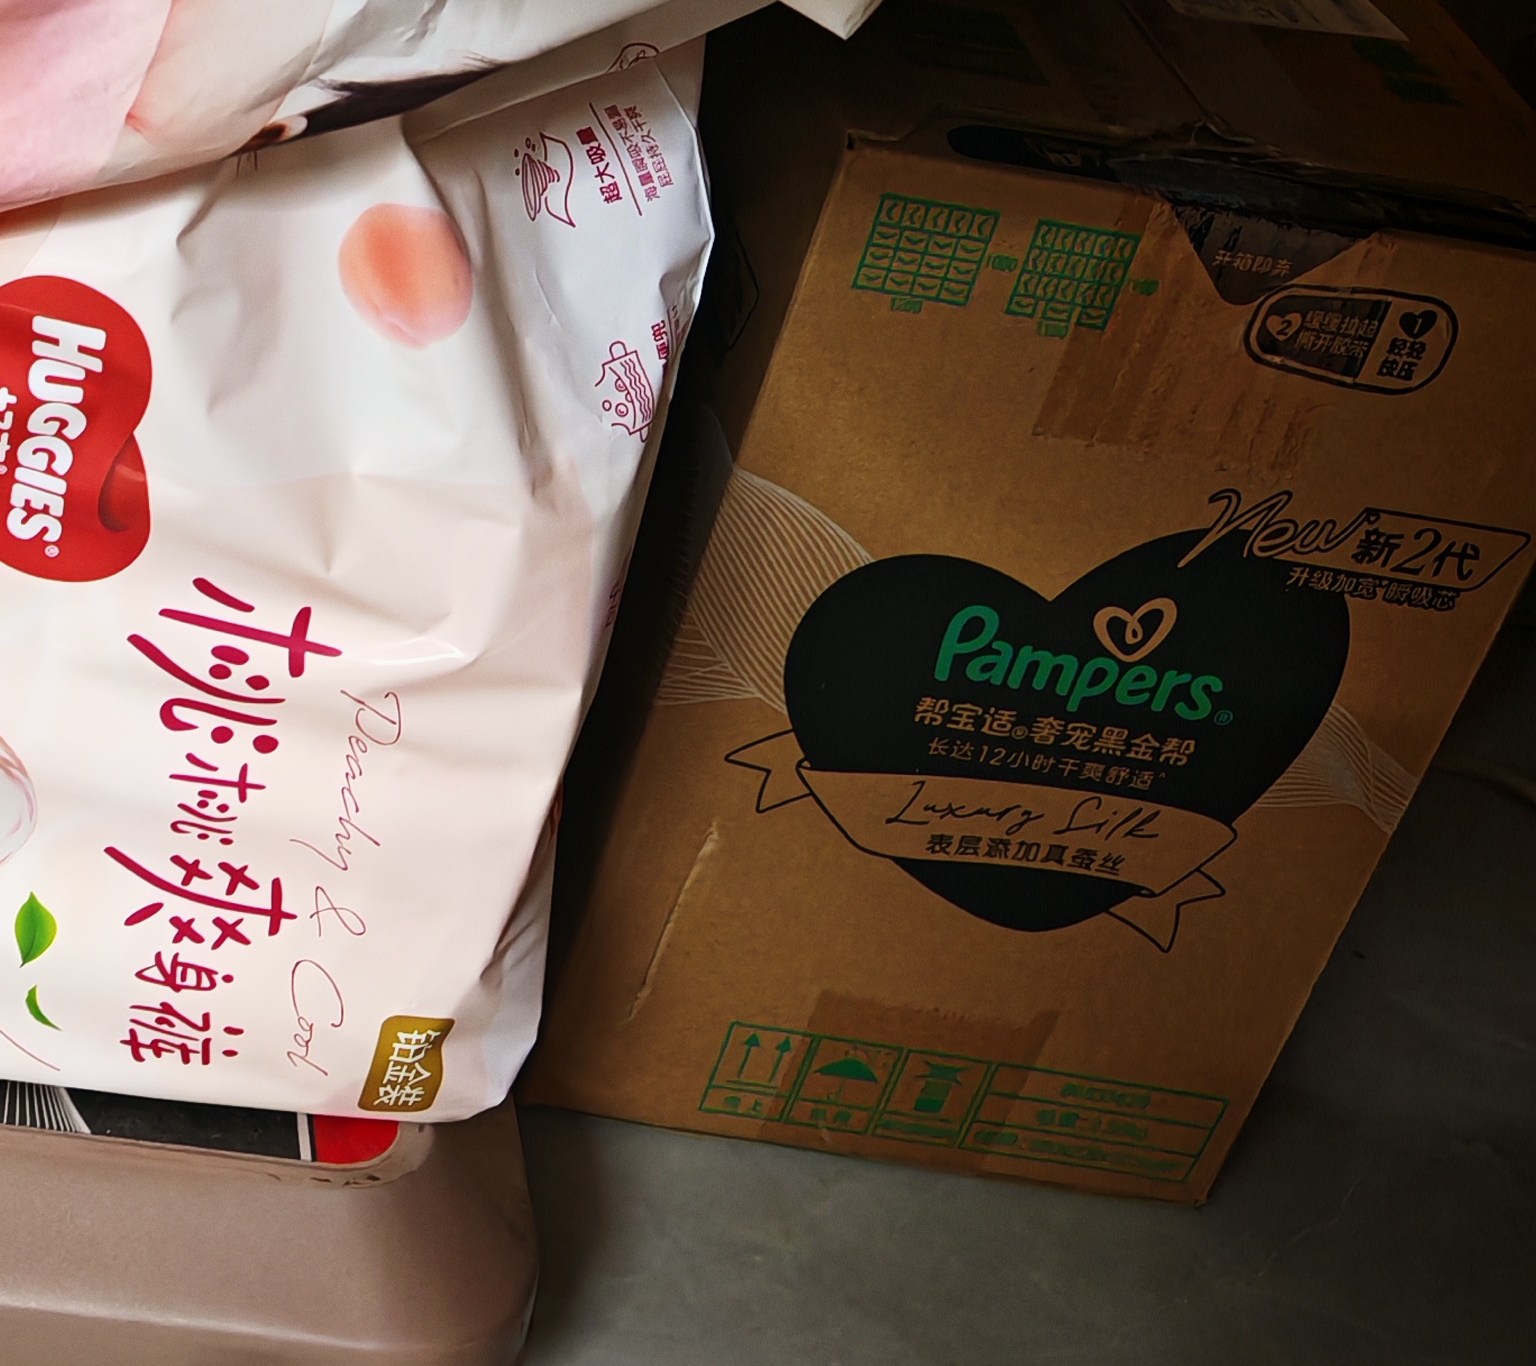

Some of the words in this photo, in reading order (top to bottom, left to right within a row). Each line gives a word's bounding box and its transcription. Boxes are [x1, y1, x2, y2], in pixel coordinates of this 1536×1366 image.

[576, 126, 624, 204] 超大吸量
[6, 315, 107, 543] HUGGIES
[1351, 526, 1481, 582] 新2代
[934, 604, 1223, 720] Pampers
[290, 689, 402, 871] Peachy
[885, 780, 1045, 835] Luxury
[1053, 796, 1161, 841] Silk
[103, 577, 343, 1066] 桃桃爽身裤
[926, 834, 1126, 876] 表层添加真蚕丝
[309, 885, 367, 937] &
[286, 959, 344, 1076] Cool
[374, 1027, 442, 1109] 铂金装
